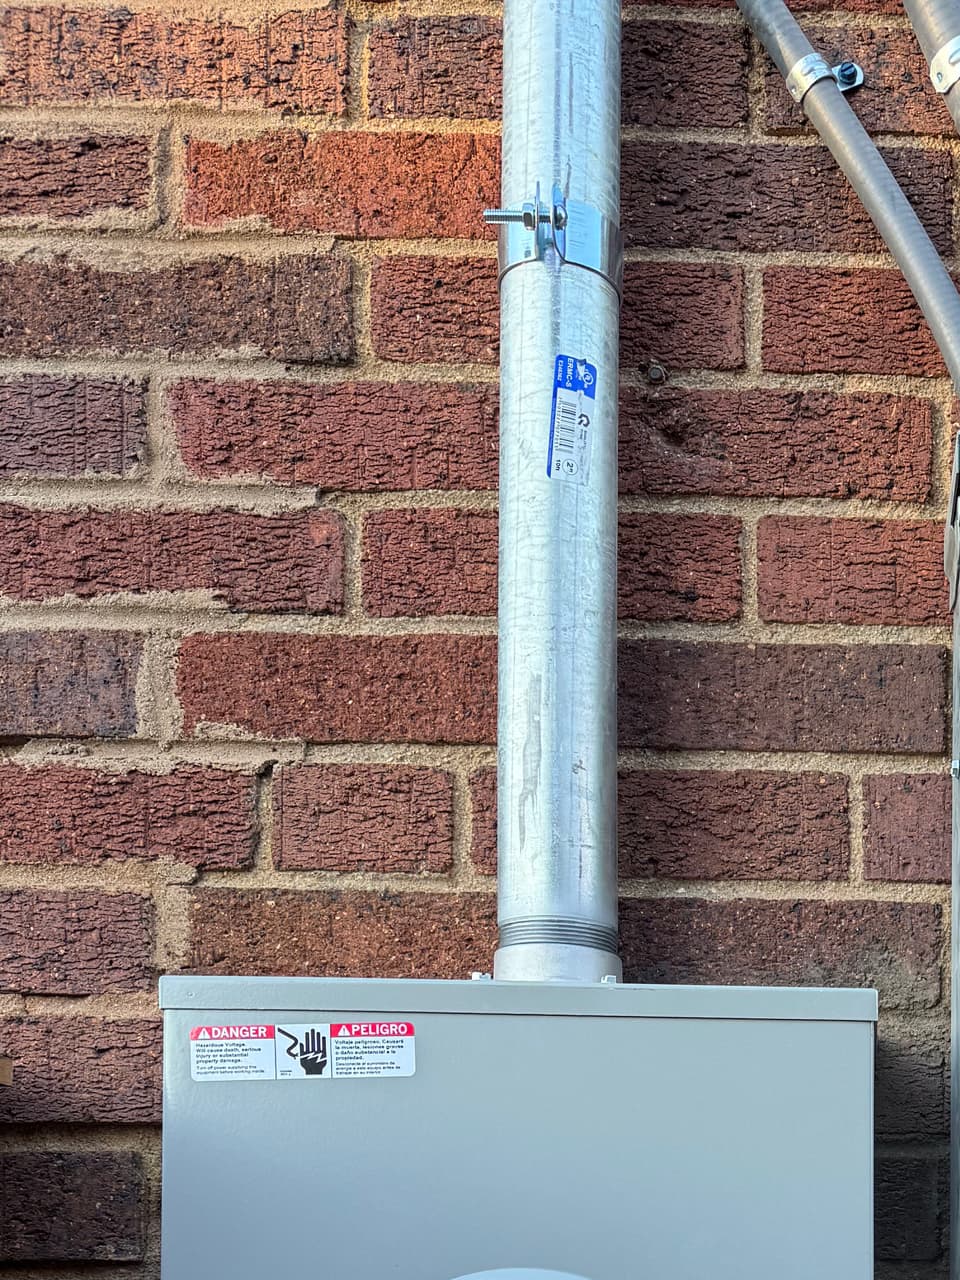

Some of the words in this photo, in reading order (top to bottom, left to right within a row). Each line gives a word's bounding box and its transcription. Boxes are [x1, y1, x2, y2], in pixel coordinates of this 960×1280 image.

[566, 357, 574, 388] ERMC-S
[211, 1026, 267, 1038] DANGER
[351, 1023, 407, 1035] PELIGRO
